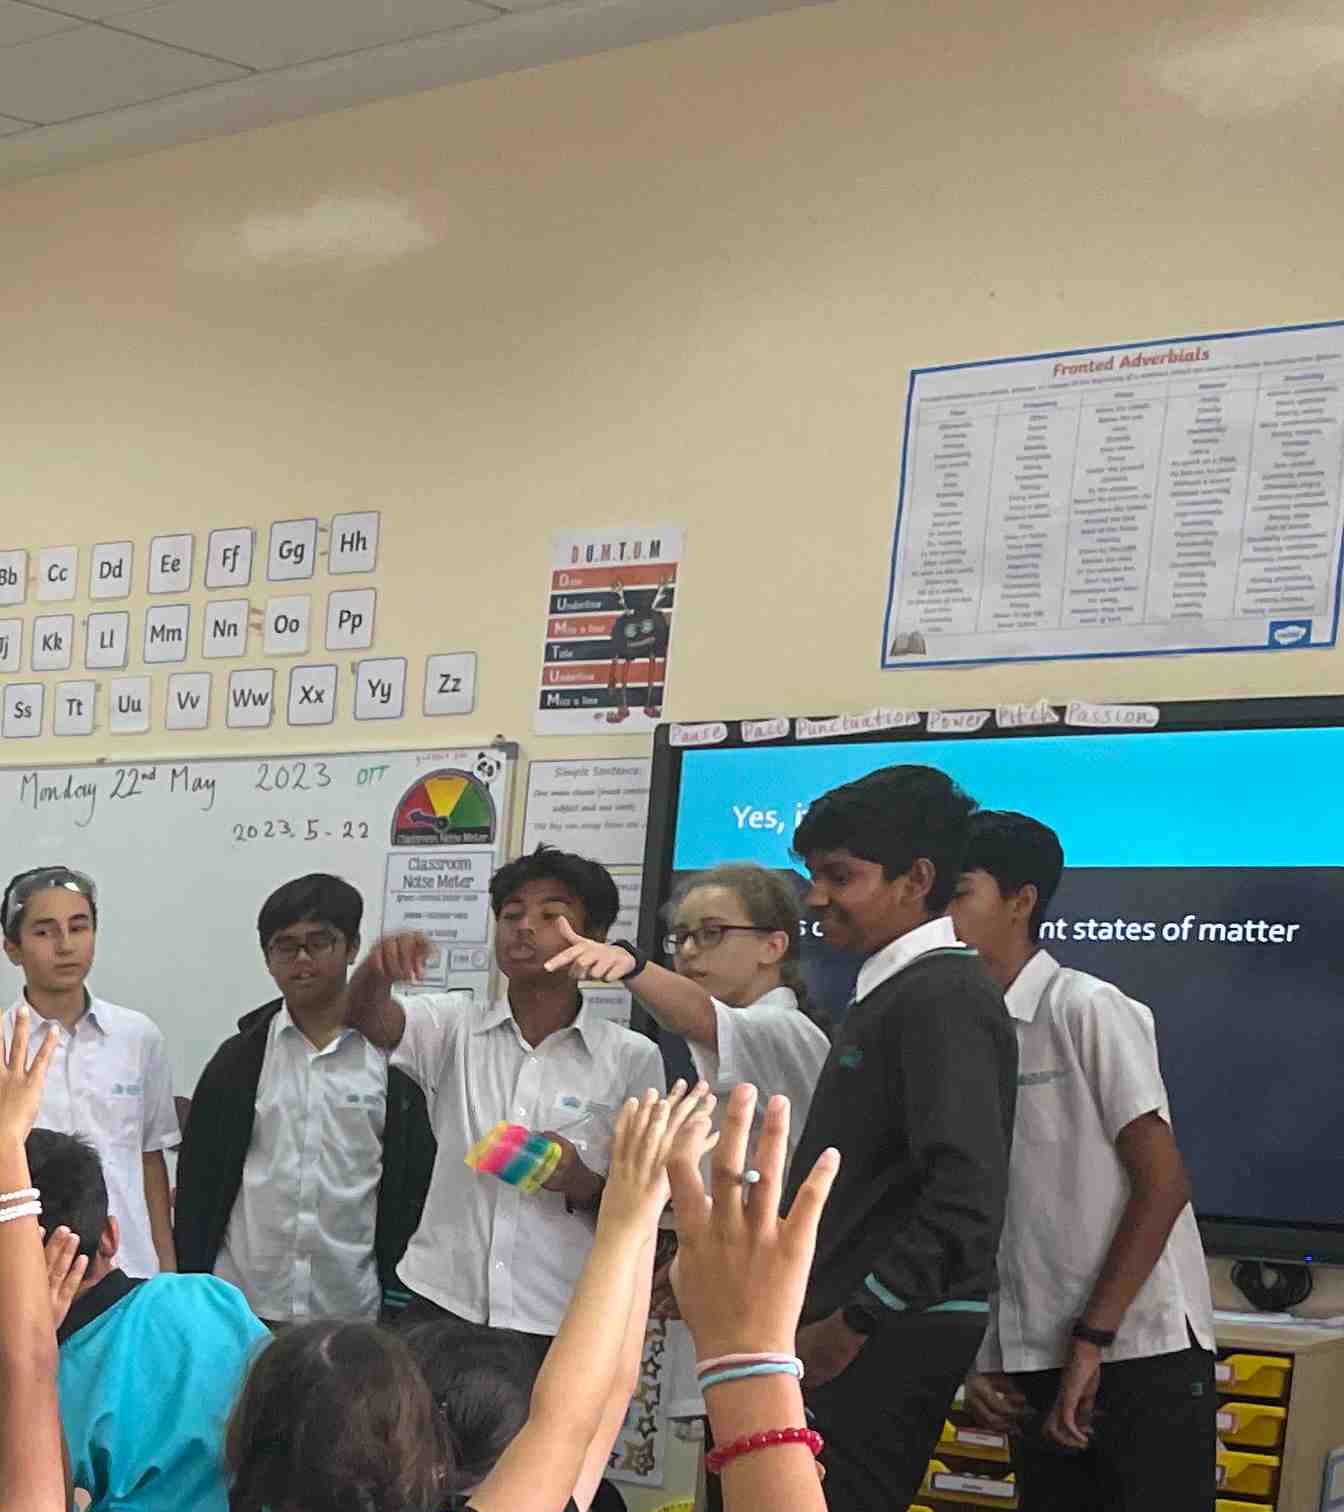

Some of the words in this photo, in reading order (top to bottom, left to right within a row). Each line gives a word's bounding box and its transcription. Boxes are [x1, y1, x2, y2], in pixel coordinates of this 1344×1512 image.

[1052, 355, 1114, 378] Fronted
[1117, 346, 1211, 371] Adverbials
[47, 564, 68, 582] Cc
[99, 558, 123, 579] Dd
[160, 554, 181, 573] Ee
[222, 545, 241, 572] Ff
[278, 540, 305, 564] Gg
[340, 530, 367, 553] Hh
[42, 631, 63, 651] Kk
[99, 628, 114, 649] Ll
[150, 624, 183, 643] Mm
[213, 618, 238, 638] Nn
[274, 614, 300, 634] Oo
[338, 609, 363, 635] Pp
[13, 701, 32, 719] Ss
[66, 697, 84, 716] Tt
[117, 695, 142, 713] Uu
[176, 691, 200, 710] Vv
[232, 688, 269, 708] Ww
[299, 684, 326, 704] Xx
[367, 678, 392, 703] Yy
[437, 673, 461, 694] Zz
[796, 710, 920, 739] Punctuation
[927, 711, 989, 732] Power
[1067, 703, 1154, 727] Passion
[20, 771, 98, 828] Monday
[169, 765, 217, 812] May
[254, 762, 333, 792] 2023
[733, 804, 786, 834] Yes,
[408, 856, 472, 872] Classroom
[403, 875, 435, 889] Noise
[437, 875, 475, 889] Meter
[1072, 916, 1160, 942] states
[1162, 914, 1196, 942] of
[1197, 917, 1300, 943] matter
